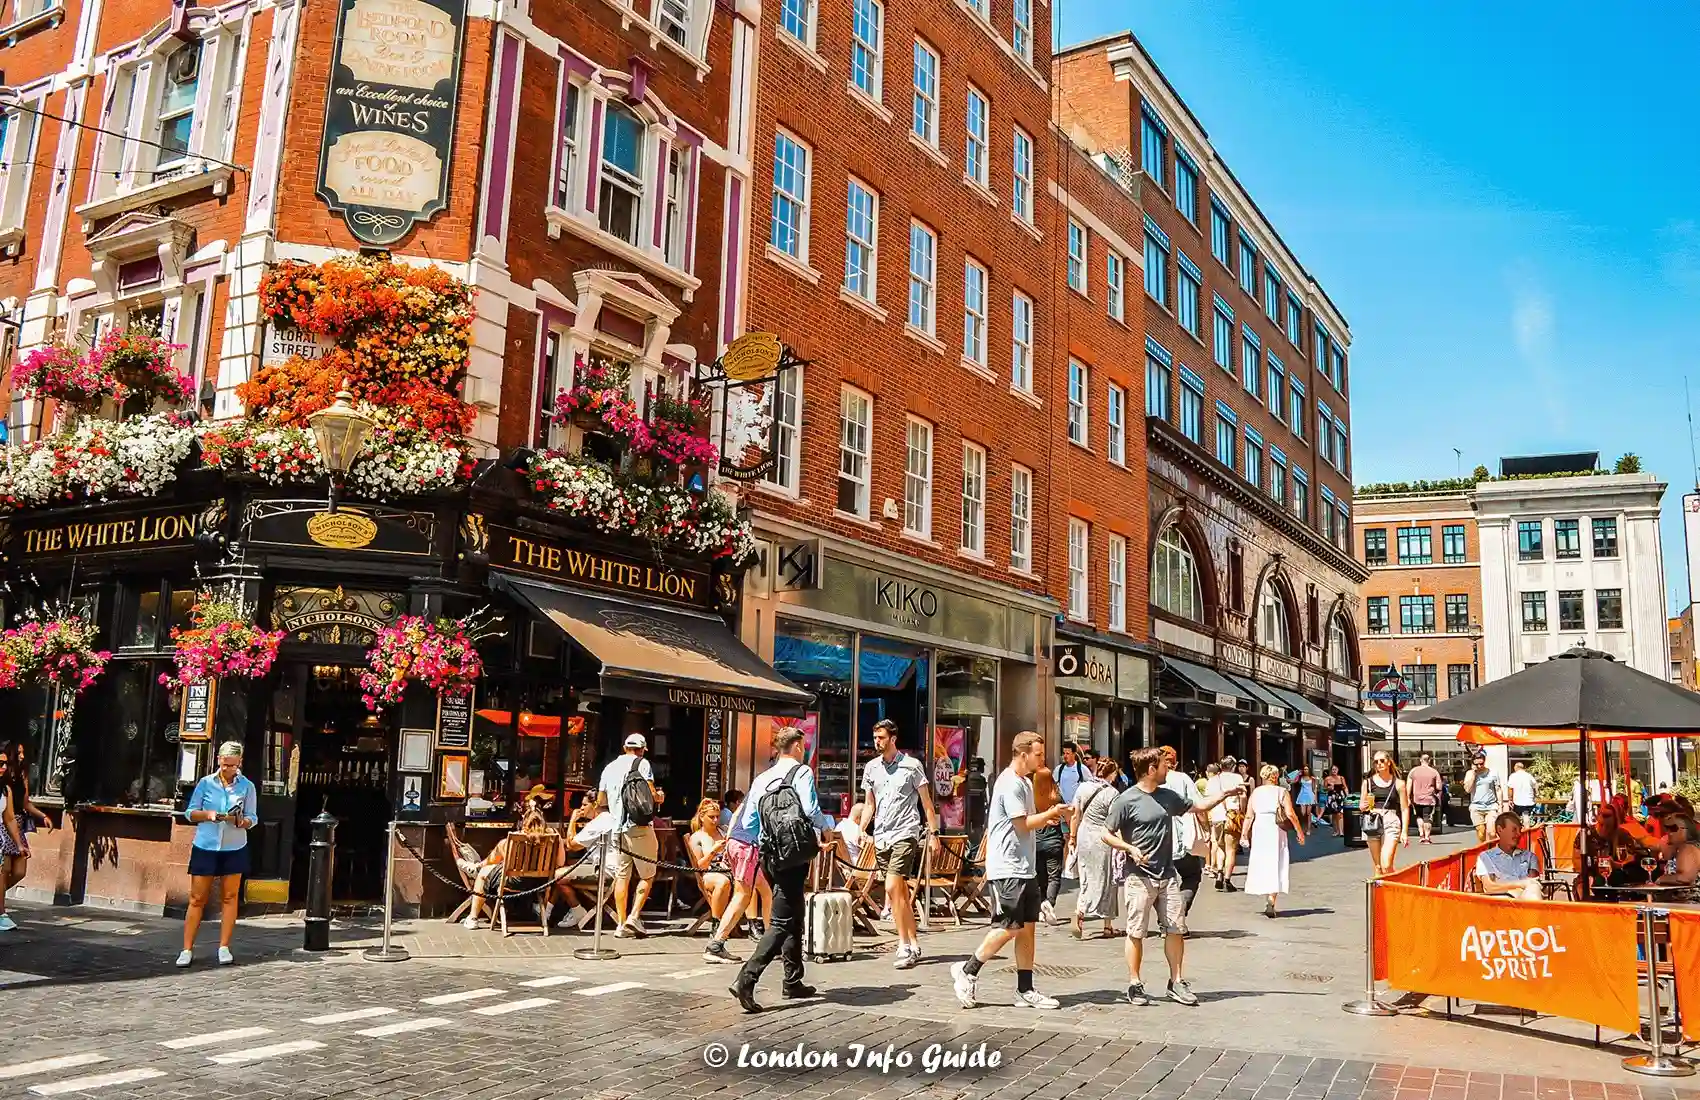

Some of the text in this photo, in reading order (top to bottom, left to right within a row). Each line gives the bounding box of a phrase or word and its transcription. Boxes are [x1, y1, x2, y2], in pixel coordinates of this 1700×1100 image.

[368, 26, 427, 48] ROOM
[335, 82, 449, 109] an Excellent choice
[349, 100, 429, 133] WINES
[383, 102, 398, 112] of
[354, 155, 413, 176] FOOD
[273, 329, 317, 344] FLORAL
[272, 342, 317, 357] STREET
[729, 348, 774, 365] NICHOLSON'S
[721, 460, 774, 478] THE WHITE LION
[24, 513, 198, 553] THE WHITE LION
[315, 520, 368, 535] NICHOLSON'S
[509, 536, 696, 599] THE WHITE LION
[875, 577, 938, 618] KIKO
[291, 613, 381, 630] NICHOLSON'S
[891, 612, 920, 627] MILANO
[1221, 643, 1251, 667] COVENT
[1266, 659, 1292, 681] GARDEN
[669, 689, 756, 712] UPSTAIRS DINING
[936, 771, 954, 782] SALE
[1460, 926, 1566, 962] APEROL
[1481, 954, 1553, 980] SPRITZ
